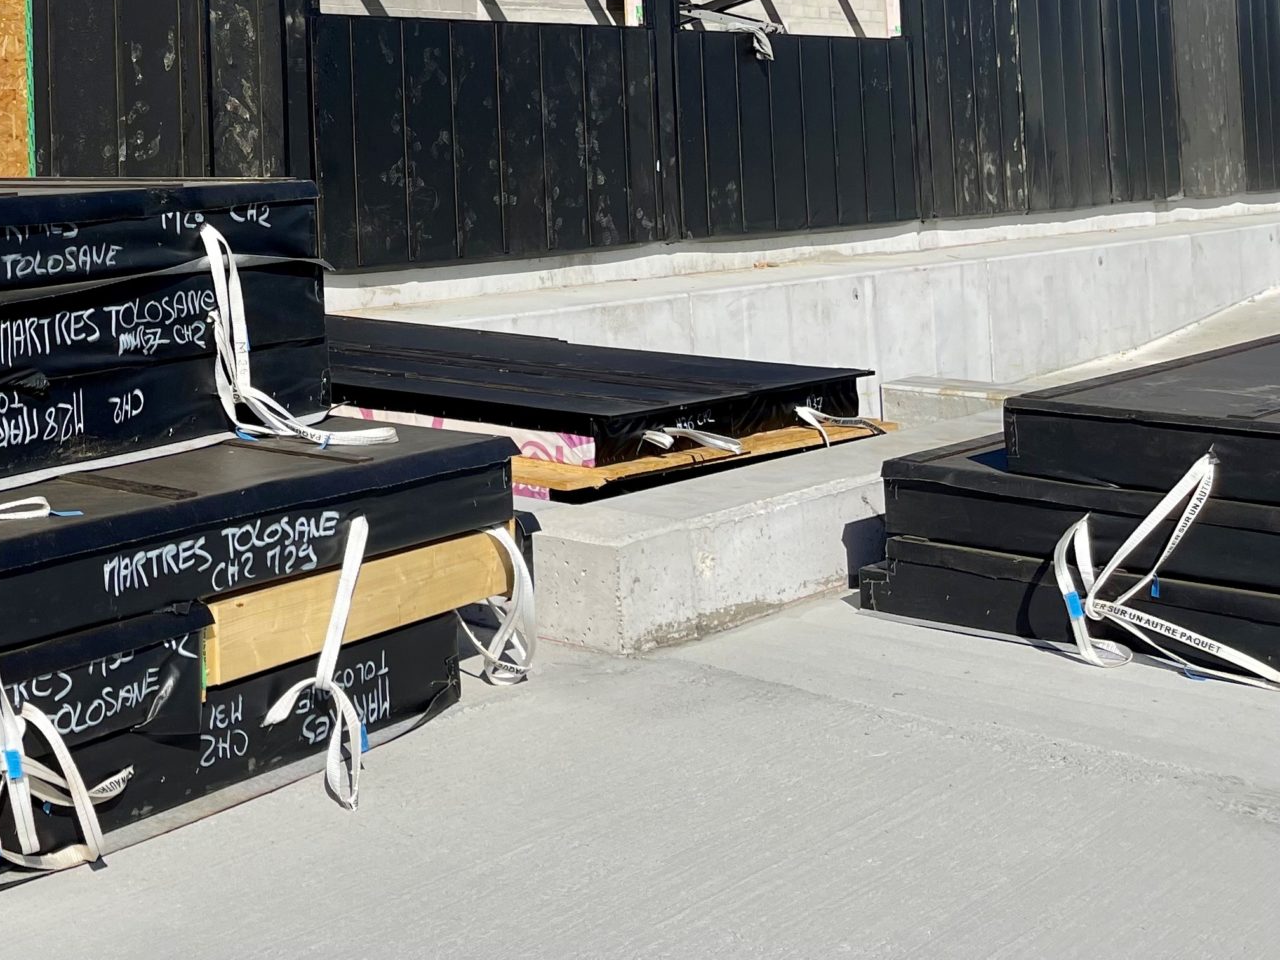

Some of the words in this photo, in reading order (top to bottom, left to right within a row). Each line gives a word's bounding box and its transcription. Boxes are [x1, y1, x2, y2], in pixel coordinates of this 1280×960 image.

[1, 243, 124, 280] TOLOSANE
[0, 308, 100, 368] MARTRES
[173, 320, 206, 348] CH2
[43, 388, 84, 445] M28
[108, 388, 144, 424] CH2
[1178, 516, 1192, 534] SUR
[1189, 503, 1200, 516] UN
[103, 536, 213, 597] MARTRES
[221, 511, 340, 559] TOLOSANE
[211, 552, 256, 591] CH2
[1107, 605, 1128, 618] SUR
[1129, 613, 1143, 623] UN
[1144, 618, 1179, 638] AUTRE
[1179, 631, 1222, 654] PAQUET
[48, 667, 160, 735] OLOSANE
[209, 694, 243, 730] M31
[200, 729, 249, 768] CH2
